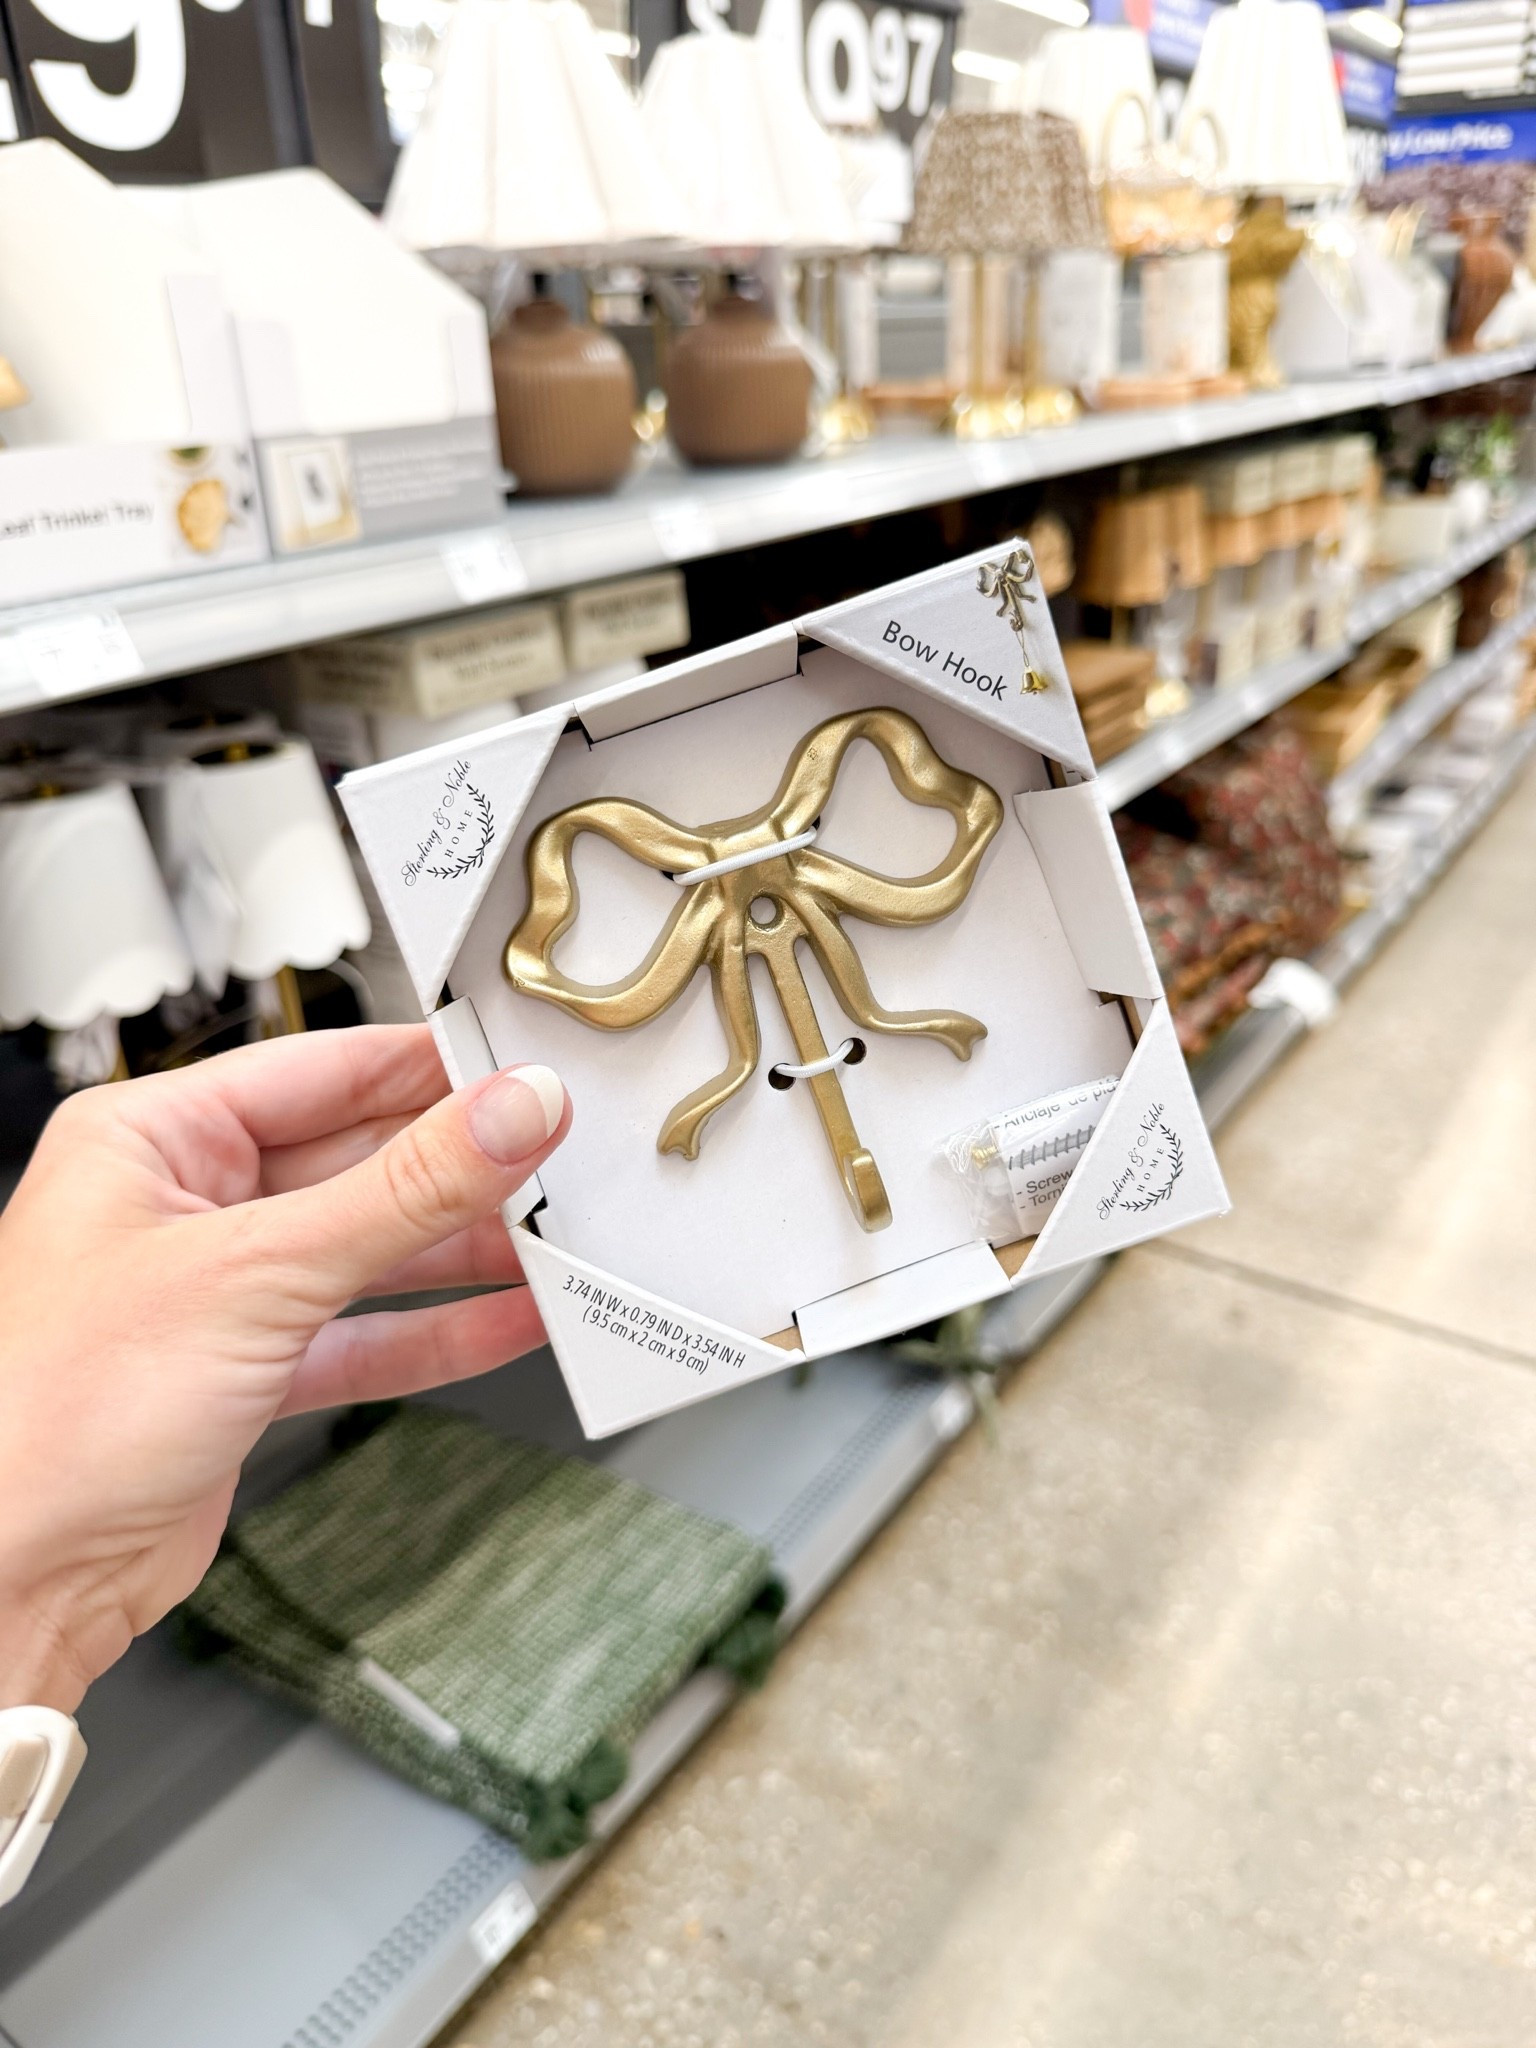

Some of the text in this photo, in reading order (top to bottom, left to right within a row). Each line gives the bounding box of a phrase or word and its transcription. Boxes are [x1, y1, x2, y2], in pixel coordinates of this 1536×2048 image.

[882, 620, 1008, 701] Bow Hook
[401, 760, 472, 887] Sterling & Noble
[1026, 1169, 1073, 1193] Screw
[1096, 1103, 1165, 1220] Sterling & Noble
[563, 1275, 591, 1299] 3.74
[630, 1307, 657, 1329] 0.79
[691, 1334, 719, 1357] 3.54
[637, 1331, 649, 1346] 2
[676, 1349, 687, 1363] 9
